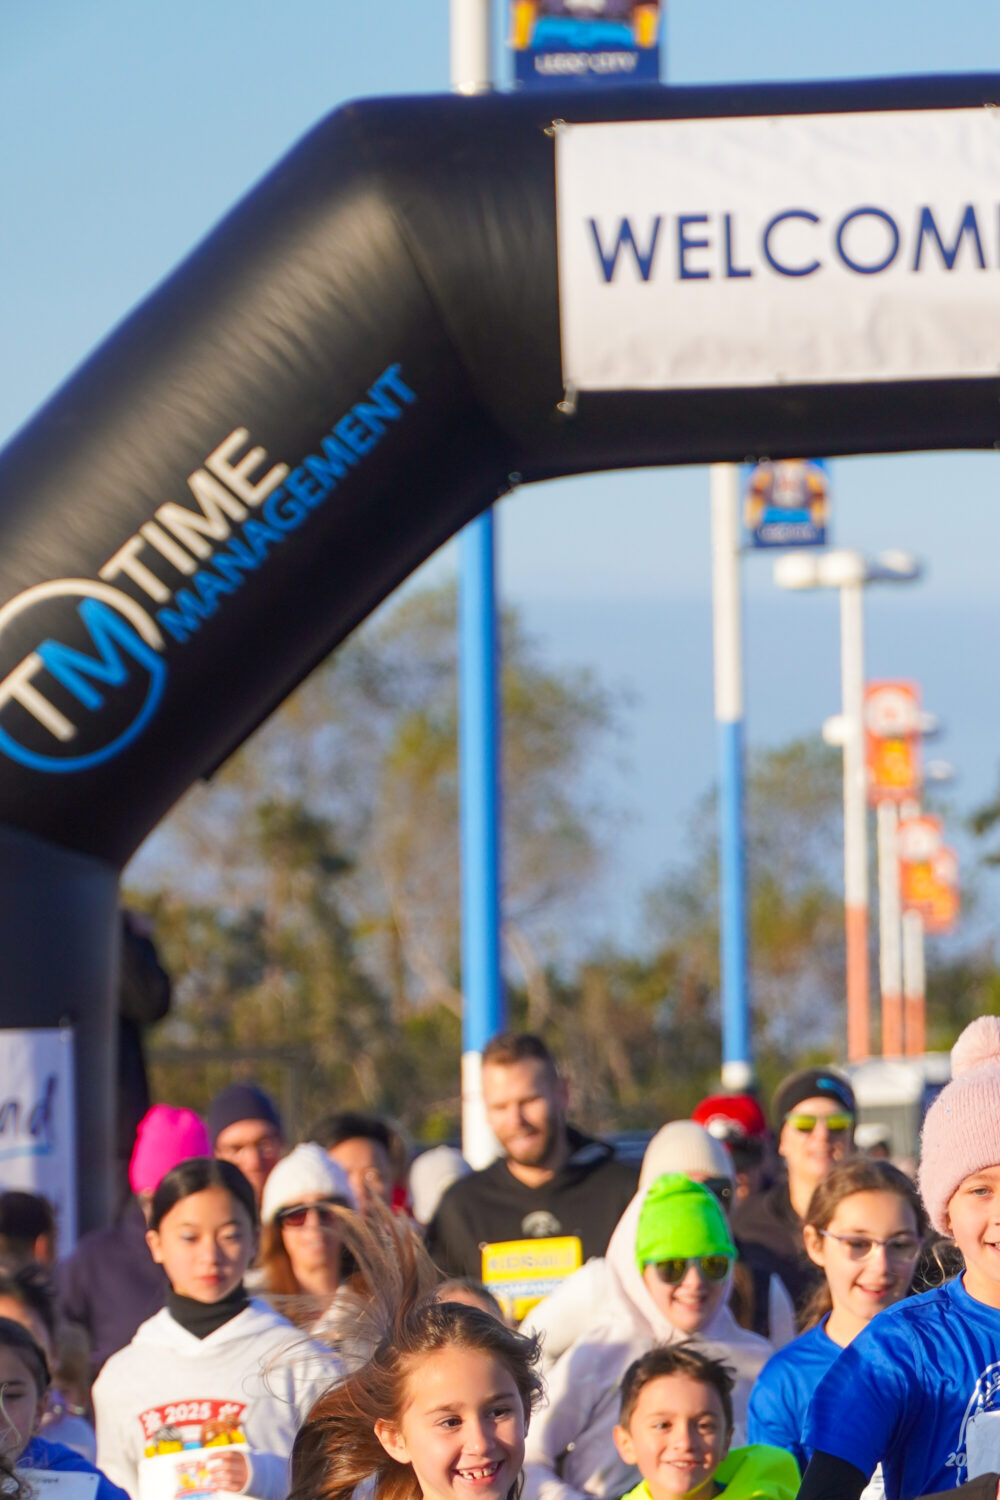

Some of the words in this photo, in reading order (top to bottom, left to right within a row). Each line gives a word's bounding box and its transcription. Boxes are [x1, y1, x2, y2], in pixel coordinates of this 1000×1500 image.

[98, 427, 290, 603] TIME
[156, 363, 417, 643] MANAGEMENT
[164, 1402, 211, 1424] 2025
